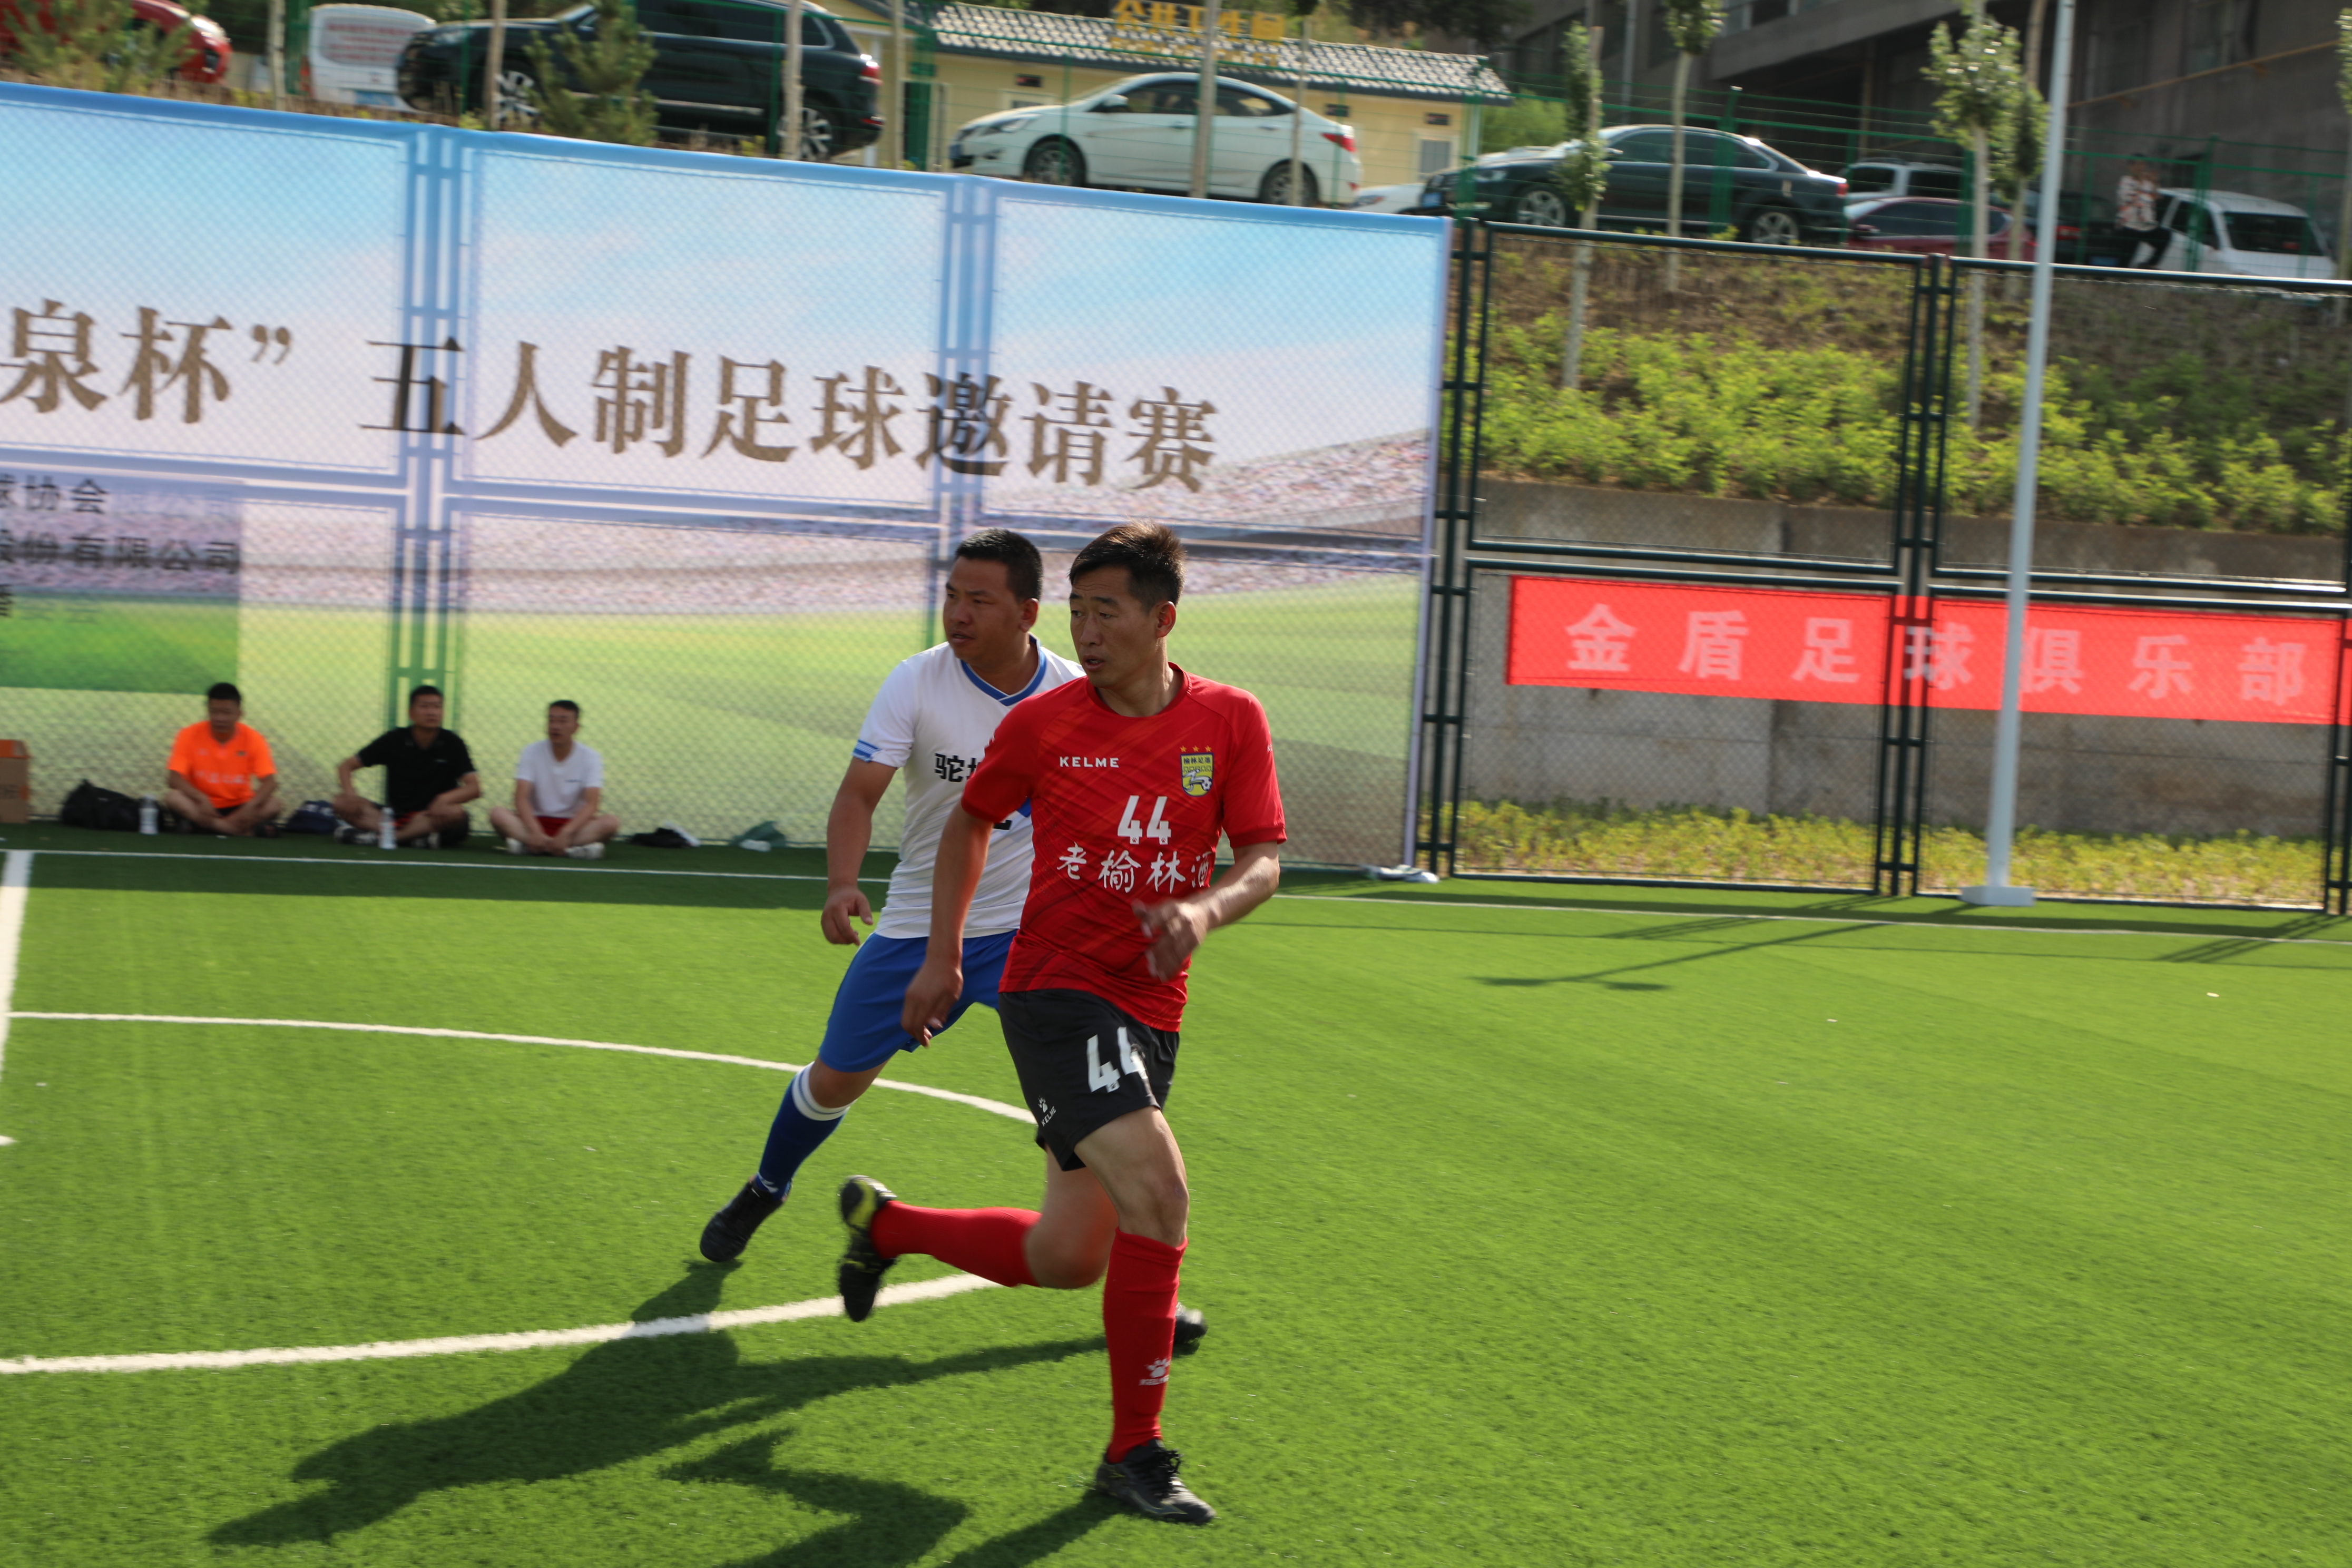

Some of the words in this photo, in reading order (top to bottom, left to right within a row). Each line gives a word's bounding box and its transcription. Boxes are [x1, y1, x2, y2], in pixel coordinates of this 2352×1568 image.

[1566, 603, 2306, 705] 金盾足球俱乐部
[934, 752, 982, 782] 驼
[1059, 756, 1119, 768] KELME
[1117, 795, 1172, 845] 44
[1041, 1105, 1057, 1127] KELME
